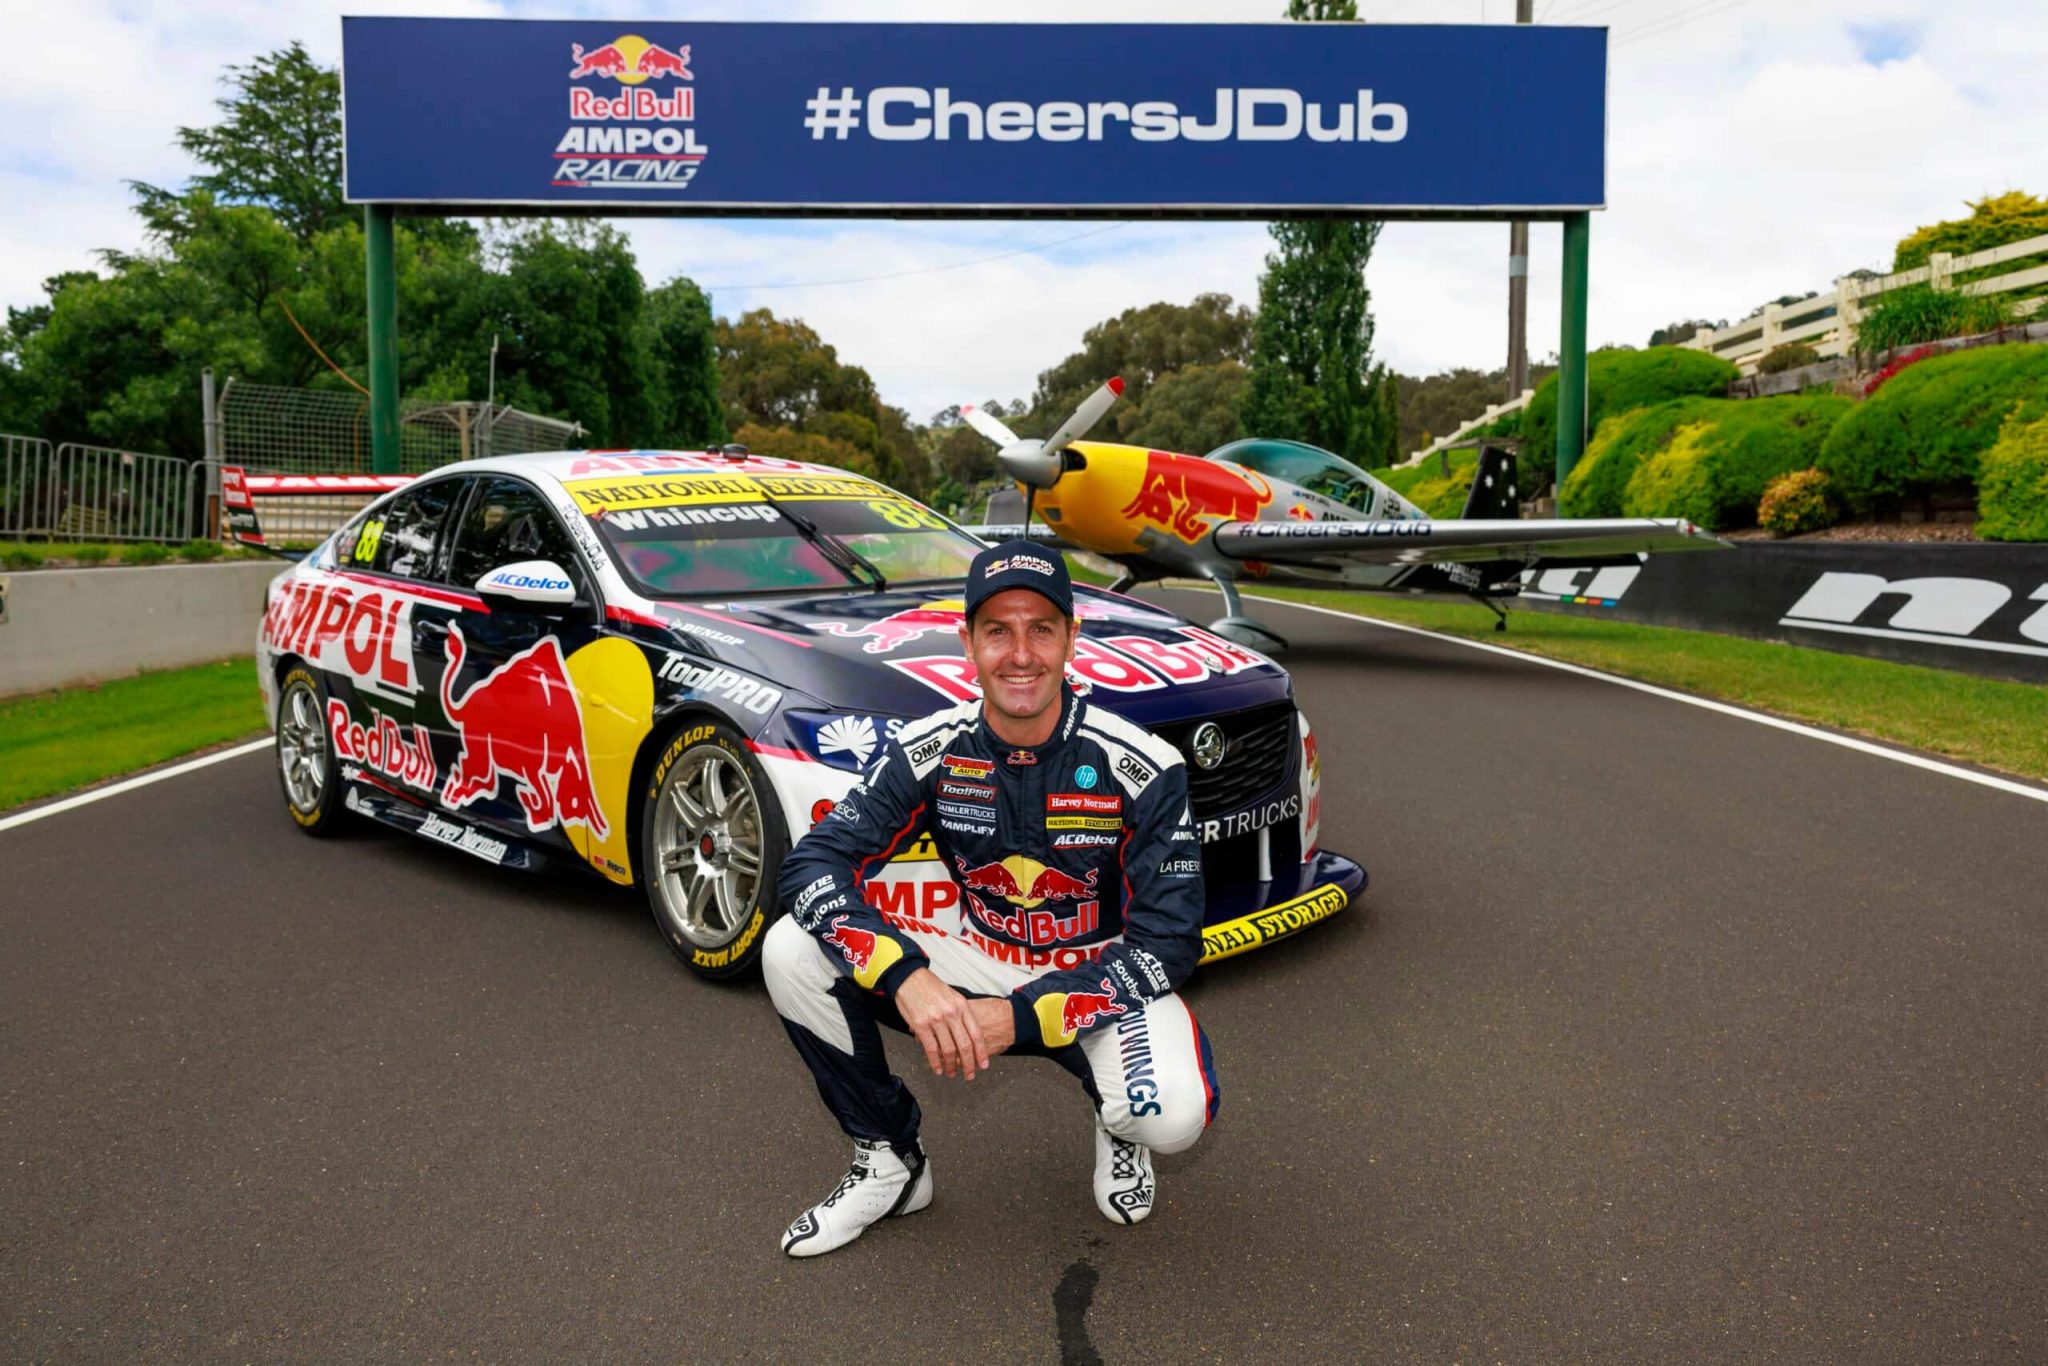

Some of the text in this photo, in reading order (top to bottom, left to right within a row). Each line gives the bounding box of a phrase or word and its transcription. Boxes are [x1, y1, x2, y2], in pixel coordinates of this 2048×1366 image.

[804, 86, 1408, 142] #CheersJDub
[555, 128, 708, 154] AMPOL
[553, 160, 698, 181] RACING
[576, 478, 755, 504] NATIONAL
[604, 503, 781, 532] Whincup
[1237, 521, 1432, 539] #CheersJDub
[355, 520, 385, 562] 88
[1011, 554, 1056, 572] AMPOL
[491, 572, 570, 590] ACDelco
[261, 578, 409, 688] AMPOL
[679, 622, 746, 646] DUNLOP
[656, 651, 783, 716] ToolPRO
[327, 696, 438, 793] Red Bull
[655, 725, 717, 786] DUNLOP
[911, 739, 942, 764] OMP
[957, 768, 982, 776] AUTO
[1077, 767, 1096, 788] hp
[1119, 756, 1151, 783] OMP
[942, 783, 993, 799] ToolPRO
[1051, 797, 1119, 809] Harvey Norman
[1047, 819, 1120, 828] NATIONAL STORAGE
[1223, 795, 1298, 838] TRUCKS
[419, 811, 508, 862] Harvey Norman
[1054, 833, 1118, 846] ACDelco
[966, 890, 1100, 946] Red Bull
[1256, 891, 1342, 938] STORAGE
